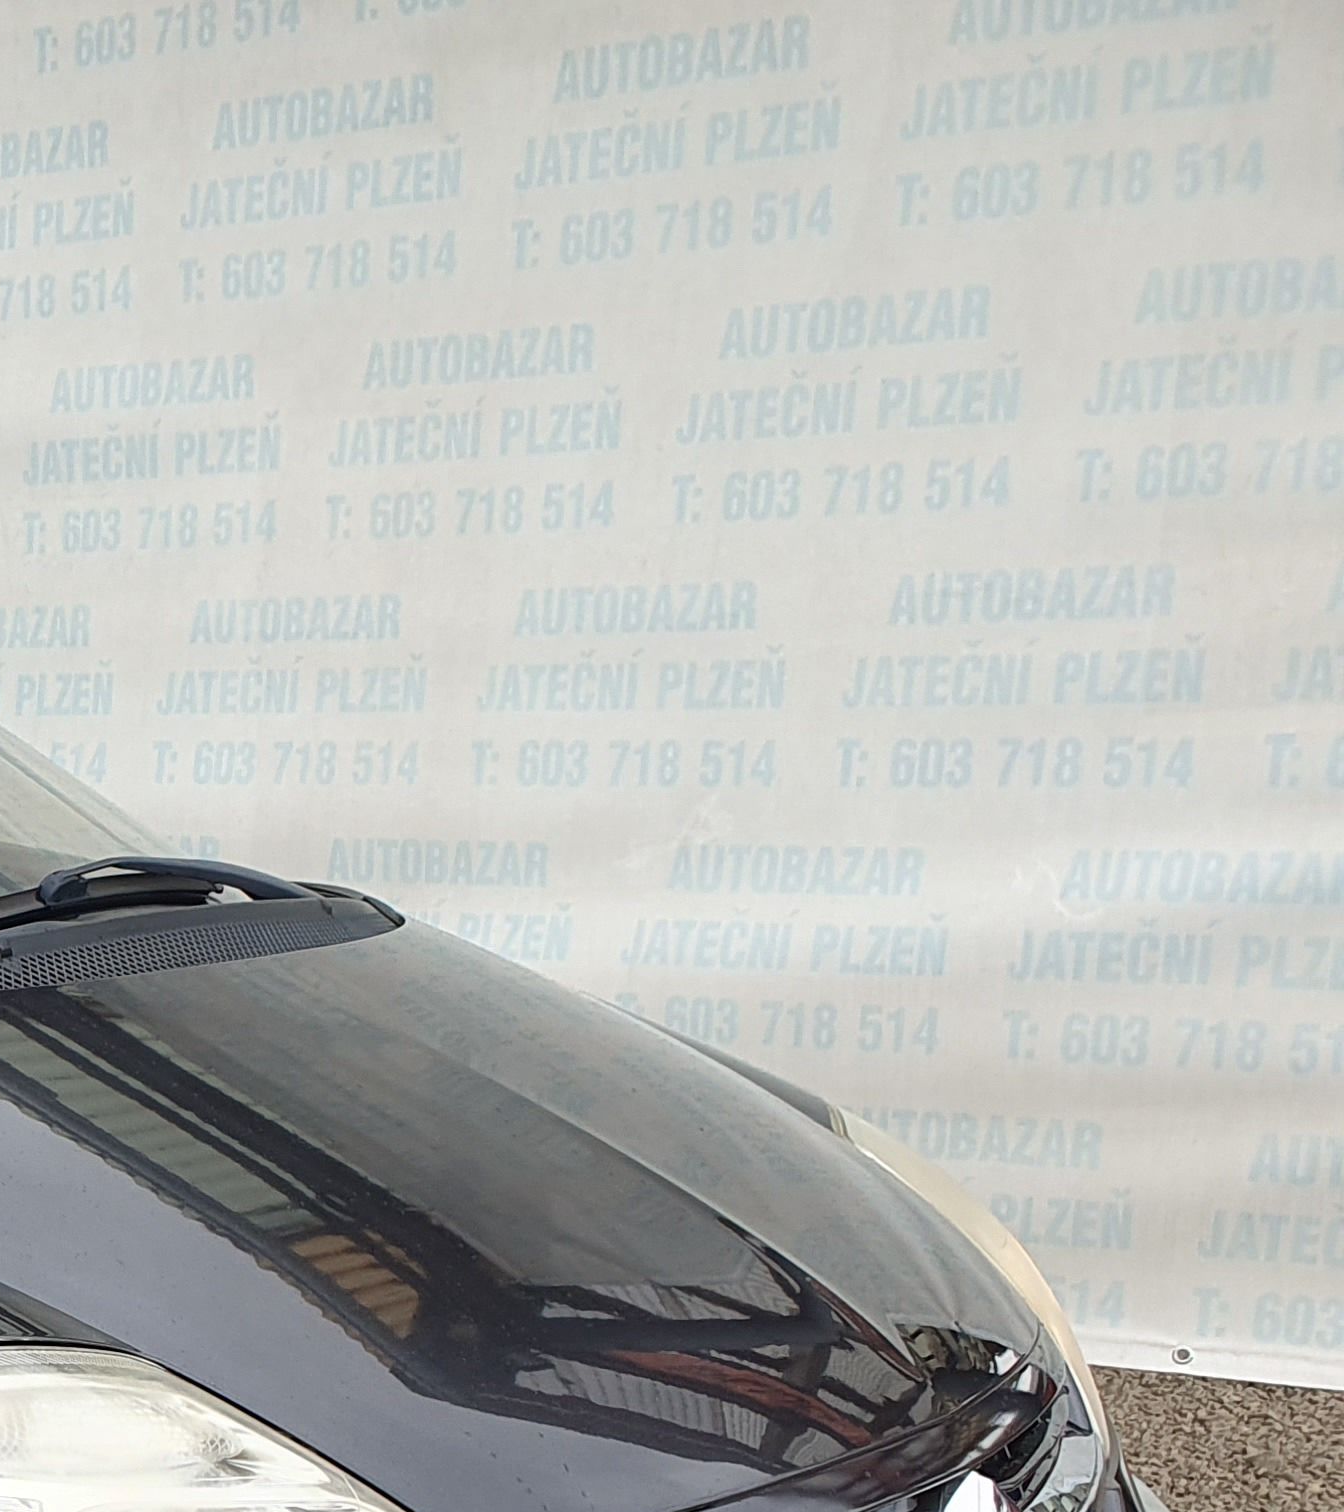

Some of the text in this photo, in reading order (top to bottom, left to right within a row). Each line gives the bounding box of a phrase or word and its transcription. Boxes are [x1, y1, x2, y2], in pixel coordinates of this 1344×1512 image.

[75, 1, 216, 67] 603 718
[553, 14, 811, 104] AUTOBAZAR
[212, 72, 434, 151] AUTOBAZAR
[901, 44, 1103, 141] JATEČNÍ
[1121, 22, 1275, 115] PLZEŇ
[515, 80, 842, 192] JATEČNÍ PLZEŇ
[33, 175, 134, 245] PLZEŇ
[181, 132, 462, 231] JATEČNÍ PLZEŇ
[896, 137, 1265, 227] T: 603 718 514
[512, 184, 833, 271] T: 603 718 514
[71, 265, 131, 314] 514
[222, 229, 457, 300] 603 718 514
[719, 284, 991, 361] AUTOBAZAR
[50, 353, 255, 415] AUTOBAZAR
[362, 323, 595, 390] AUTOBAZAR
[1084, 330, 1297, 416] JATEČNÍ
[329, 385, 622, 468] JATEČNÍ PLZEŇ
[675, 351, 1023, 447] JATEČNÍ PLZEŇ
[23, 410, 281, 488] JATEČNÍ PLZEŇ
[1077, 441, 1227, 502] T: 603
[369, 480, 615, 541] 603 718 514
[671, 455, 1011, 524] T: 603 718 514
[62, 500, 277, 554] 603 718 514
[190, 594, 402, 644] AUTOBAZAR
[516, 581, 757, 637] AUTOBAZAR
[889, 563, 1176, 626] AUTOBAZAR
[15, 660, 114, 715] PLZEŇ
[157, 654, 428, 716] JATEČNÍ PLZEŇ
[477, 645, 786, 712] JATEČNÍ PLZEŇ
[842, 637, 1040, 708] JATEČNÍ
[1053, 633, 1207, 704] PLZEŇ
[193, 741, 420, 785] 603 718 514
[518, 738, 776, 787] 603 718 514
[837, 736, 1195, 789] T: 603 718 514
[328, 838, 549, 889] AUTOBAZAR
[669, 843, 926, 897] AUTOBAZAR
[620, 908, 950, 977] JATEČNÍ PLZEŇ
[1012, 916, 1222, 985] JATEČNÍ
[761, 1001, 939, 1054] 718 514
[1060, 1014, 1266, 1073] 603 718
